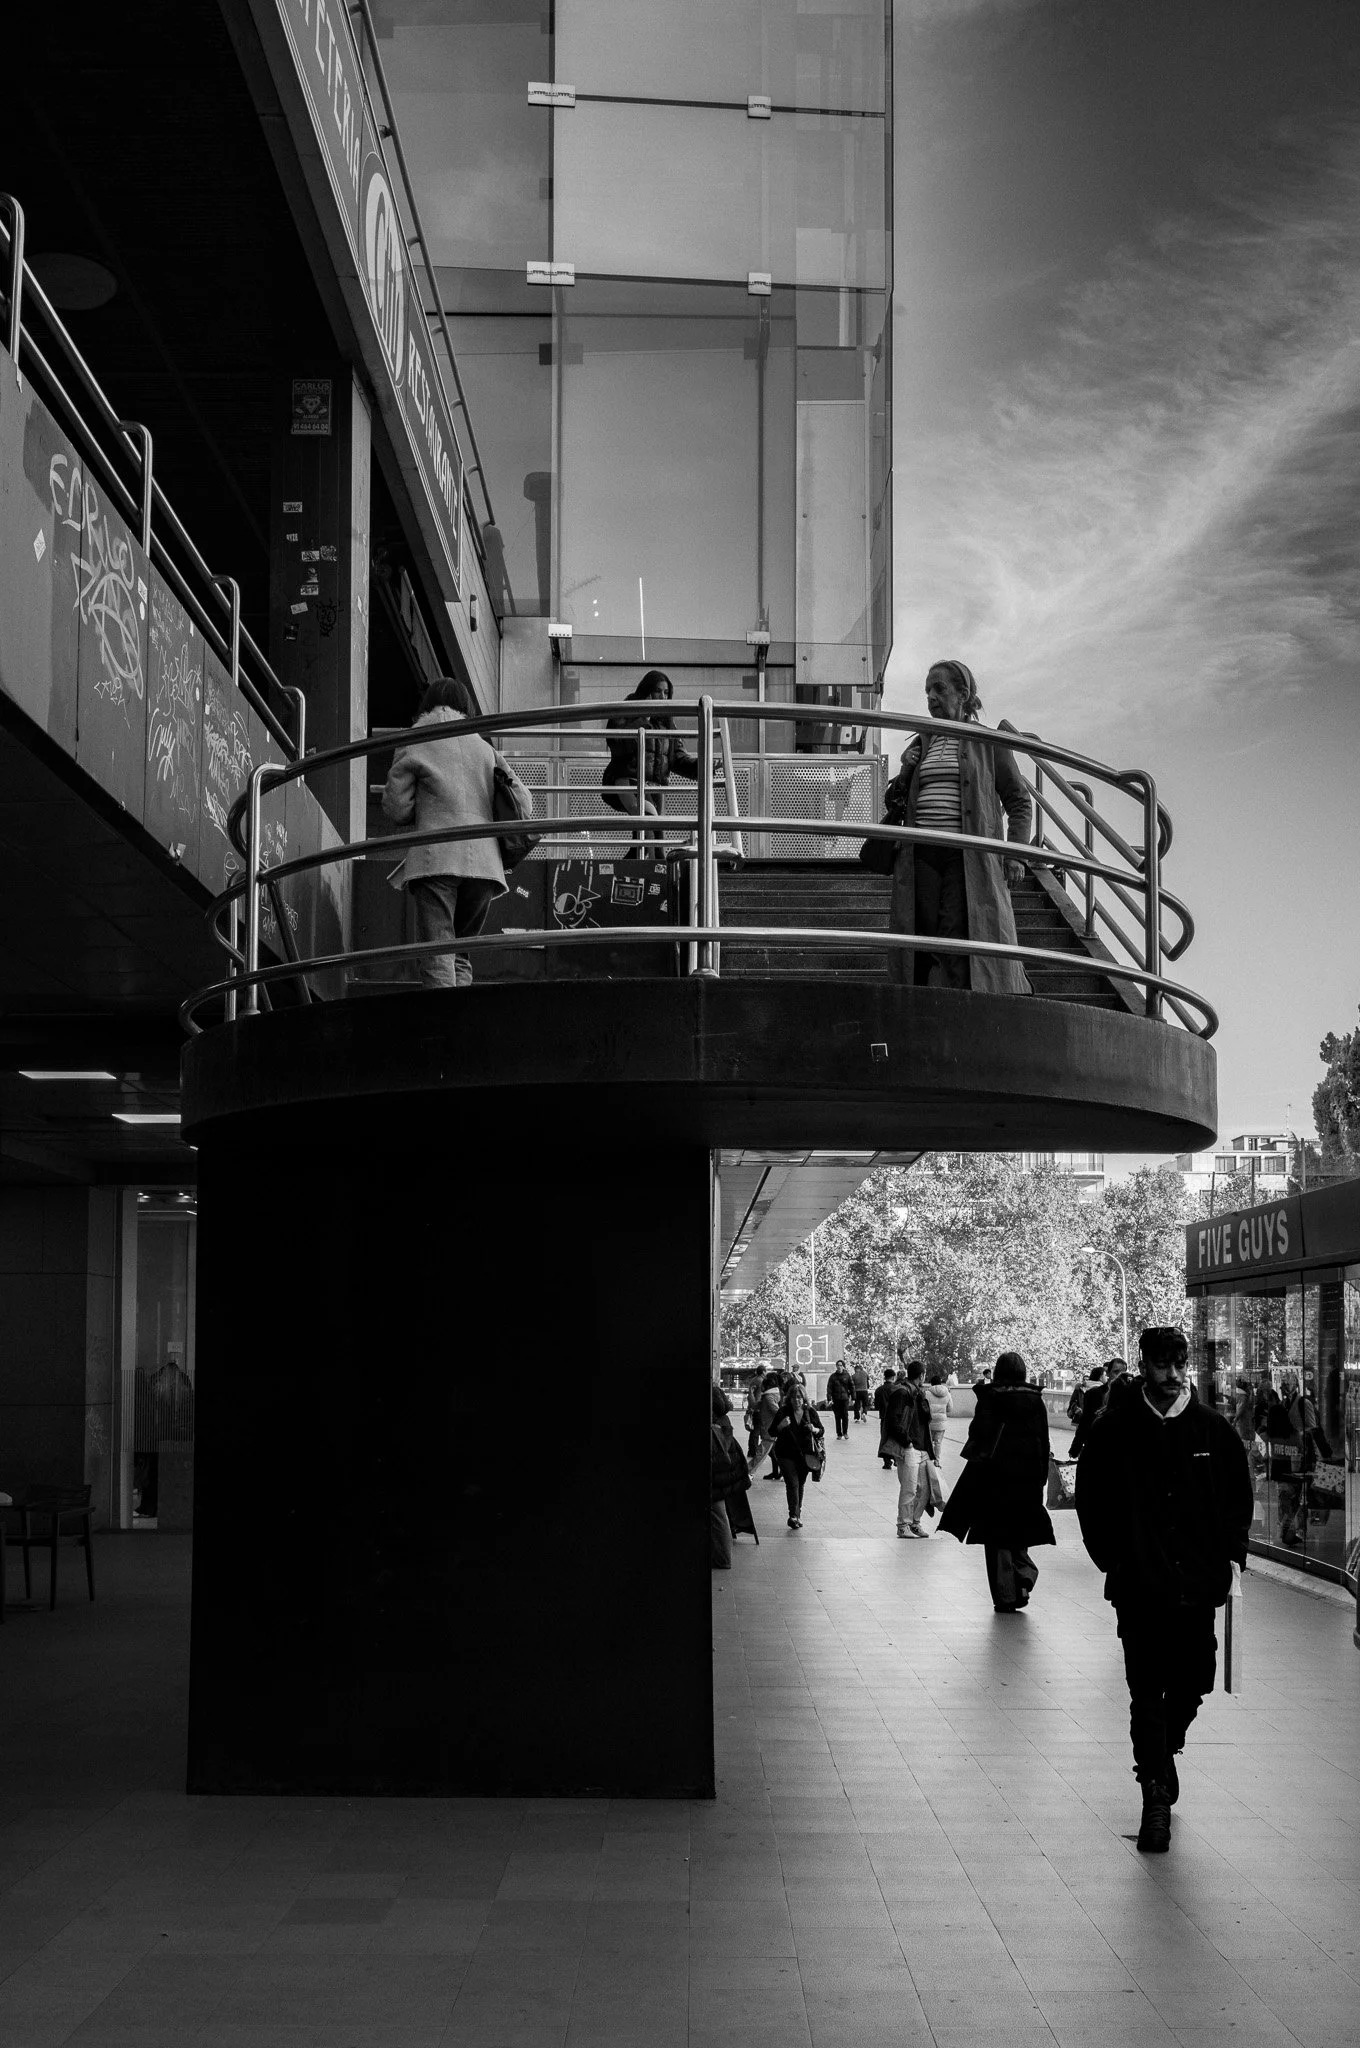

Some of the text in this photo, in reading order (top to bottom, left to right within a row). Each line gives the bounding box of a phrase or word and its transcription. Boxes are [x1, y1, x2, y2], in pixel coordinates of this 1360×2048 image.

[408, 329, 458, 540] RESTAURANTE
[1198, 1209, 1289, 1269] FIVE GUYS
[796, 1333, 836, 1365] 81
